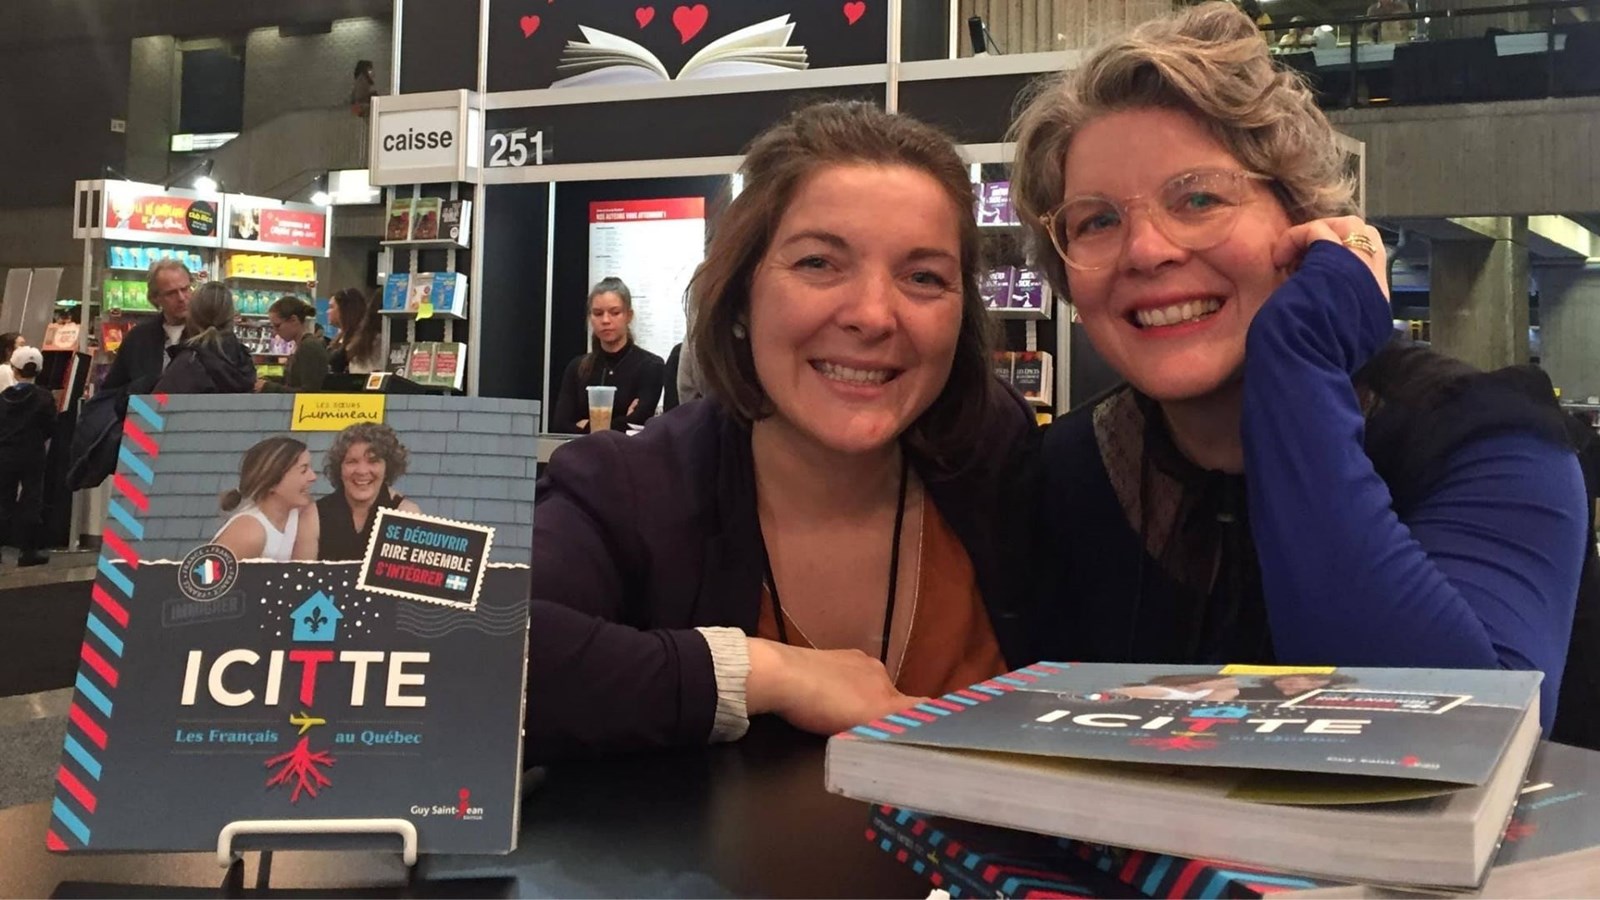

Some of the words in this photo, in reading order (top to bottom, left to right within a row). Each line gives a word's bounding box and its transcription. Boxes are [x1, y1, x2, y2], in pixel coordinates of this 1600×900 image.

[383, 128, 453, 152] caisse
[489, 130, 544, 167] 251
[298, 404, 378, 423] Lumineau
[385, 525, 402, 540] SE
[403, 526, 469, 552] DÉCOUVRIR
[182, 549, 205, 573] FRANCE
[211, 547, 233, 563] FRANCE
[380, 543, 409, 560] RIRE
[410, 548, 473, 573] ENSEMBLE
[375, 561, 444, 587] S'INTÉGRER
[180, 649, 431, 708] ICITTE
[1035, 709, 1372, 734] ICITTE
[175, 728, 204, 743] Les
[209, 728, 278, 745] Français
[336, 732, 355, 744] au
[360, 728, 422, 746] Québec
[410, 805, 430, 817] Guy
